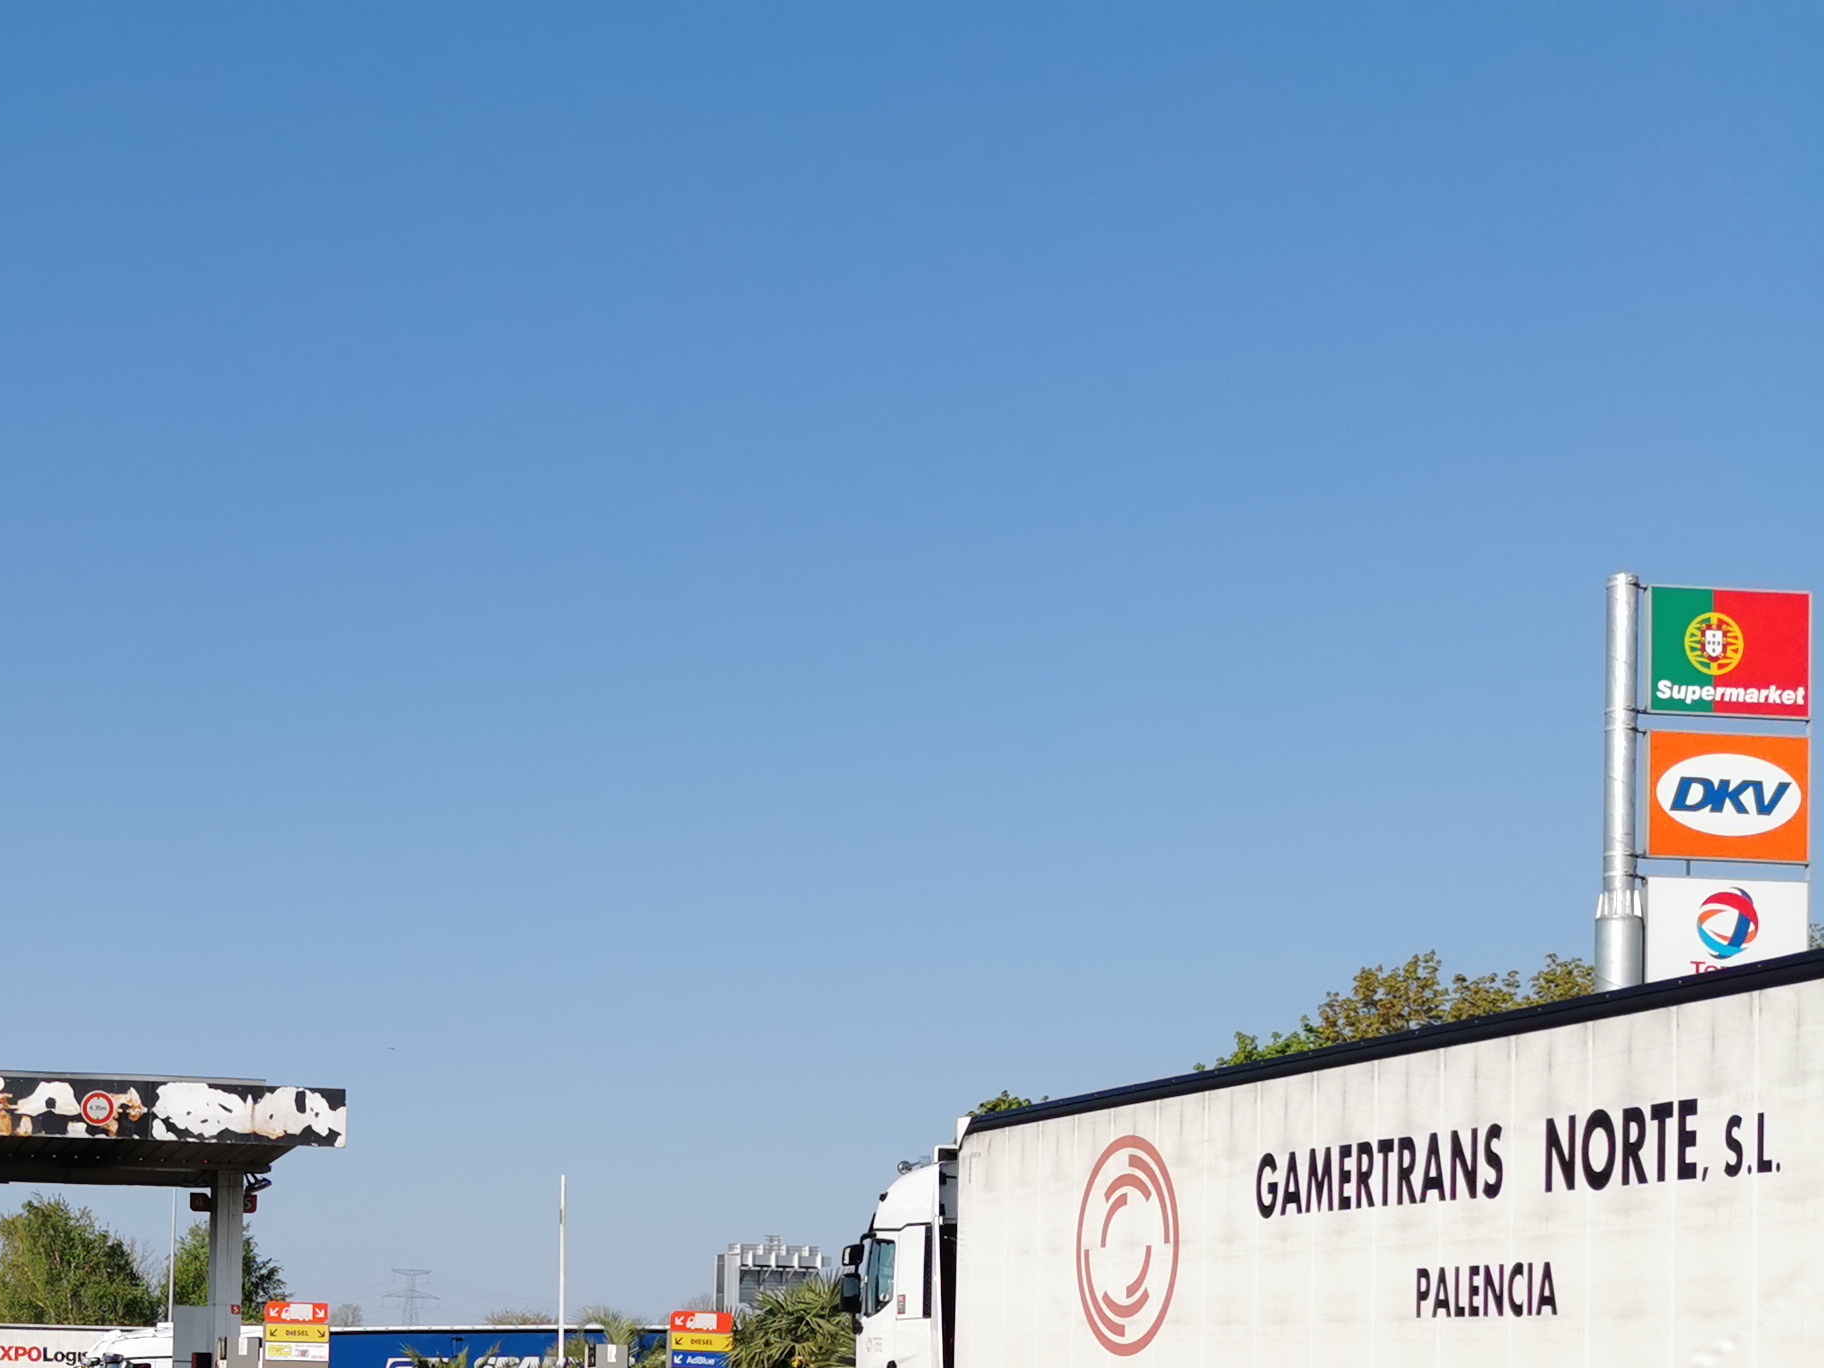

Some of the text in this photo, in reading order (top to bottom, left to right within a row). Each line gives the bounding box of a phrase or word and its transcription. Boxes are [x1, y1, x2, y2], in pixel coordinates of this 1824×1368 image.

[1656, 679, 1805, 705] Supermarket
[1669, 776, 1792, 816] DKV
[1255, 1098, 1781, 1219] GAMERTRANS NORTE, S.L.
[244, 1198, 252, 1209] 5
[1415, 1261, 1558, 1319] PALENCIA
[285, 1329, 310, 1337] DIESEL
[690, 1338, 713, 1346] DIESEL
